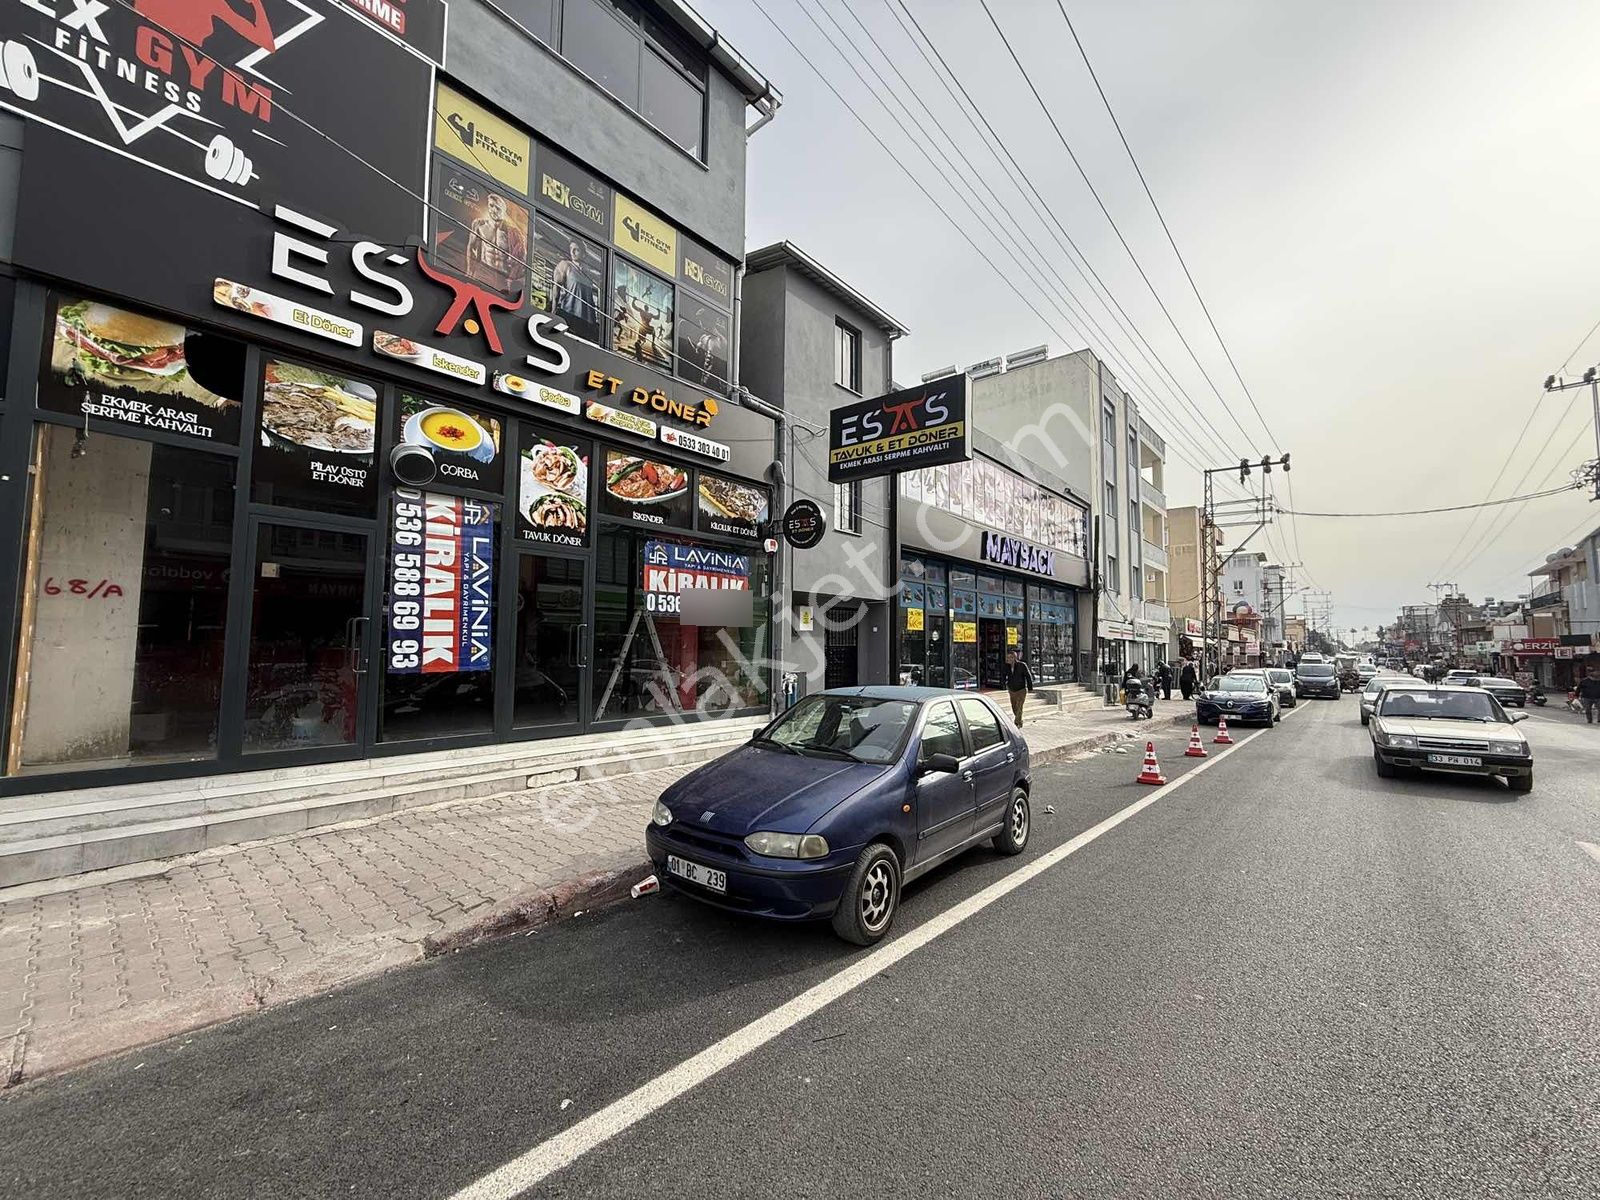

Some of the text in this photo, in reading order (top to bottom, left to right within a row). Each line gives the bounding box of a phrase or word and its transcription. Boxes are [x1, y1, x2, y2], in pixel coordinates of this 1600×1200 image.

[135, 25, 272, 123] GYM
[475, 130, 523, 163] REX GYM
[542, 173, 571, 209] REX
[569, 195, 605, 226] GYM
[293, 309, 355, 339] Et Döner
[101, 394, 198, 424] EKMEK ARASI
[587, 370, 624, 395] ET
[632, 388, 712, 428] DÖNER
[80, 402, 213, 438] SERPME KAHVALTI
[678, 434, 731, 460] 0533 303 40 01
[834, 425, 960, 462] TAVUK & ET DÖNER
[840, 441, 951, 470] EKMEK ARASI SERPME KAHVALTI
[312, 471, 326, 481] ET
[395, 502, 422, 546] 536
[523, 529, 551, 542] TAVUK
[393, 553, 421, 596] 588
[422, 490, 461, 666] KİRALIK
[392, 601, 420, 630] 69
[646, 593, 656, 612] 0
[391, 640, 419, 668] 93
[671, 857, 725, 889] 01 BC 239
